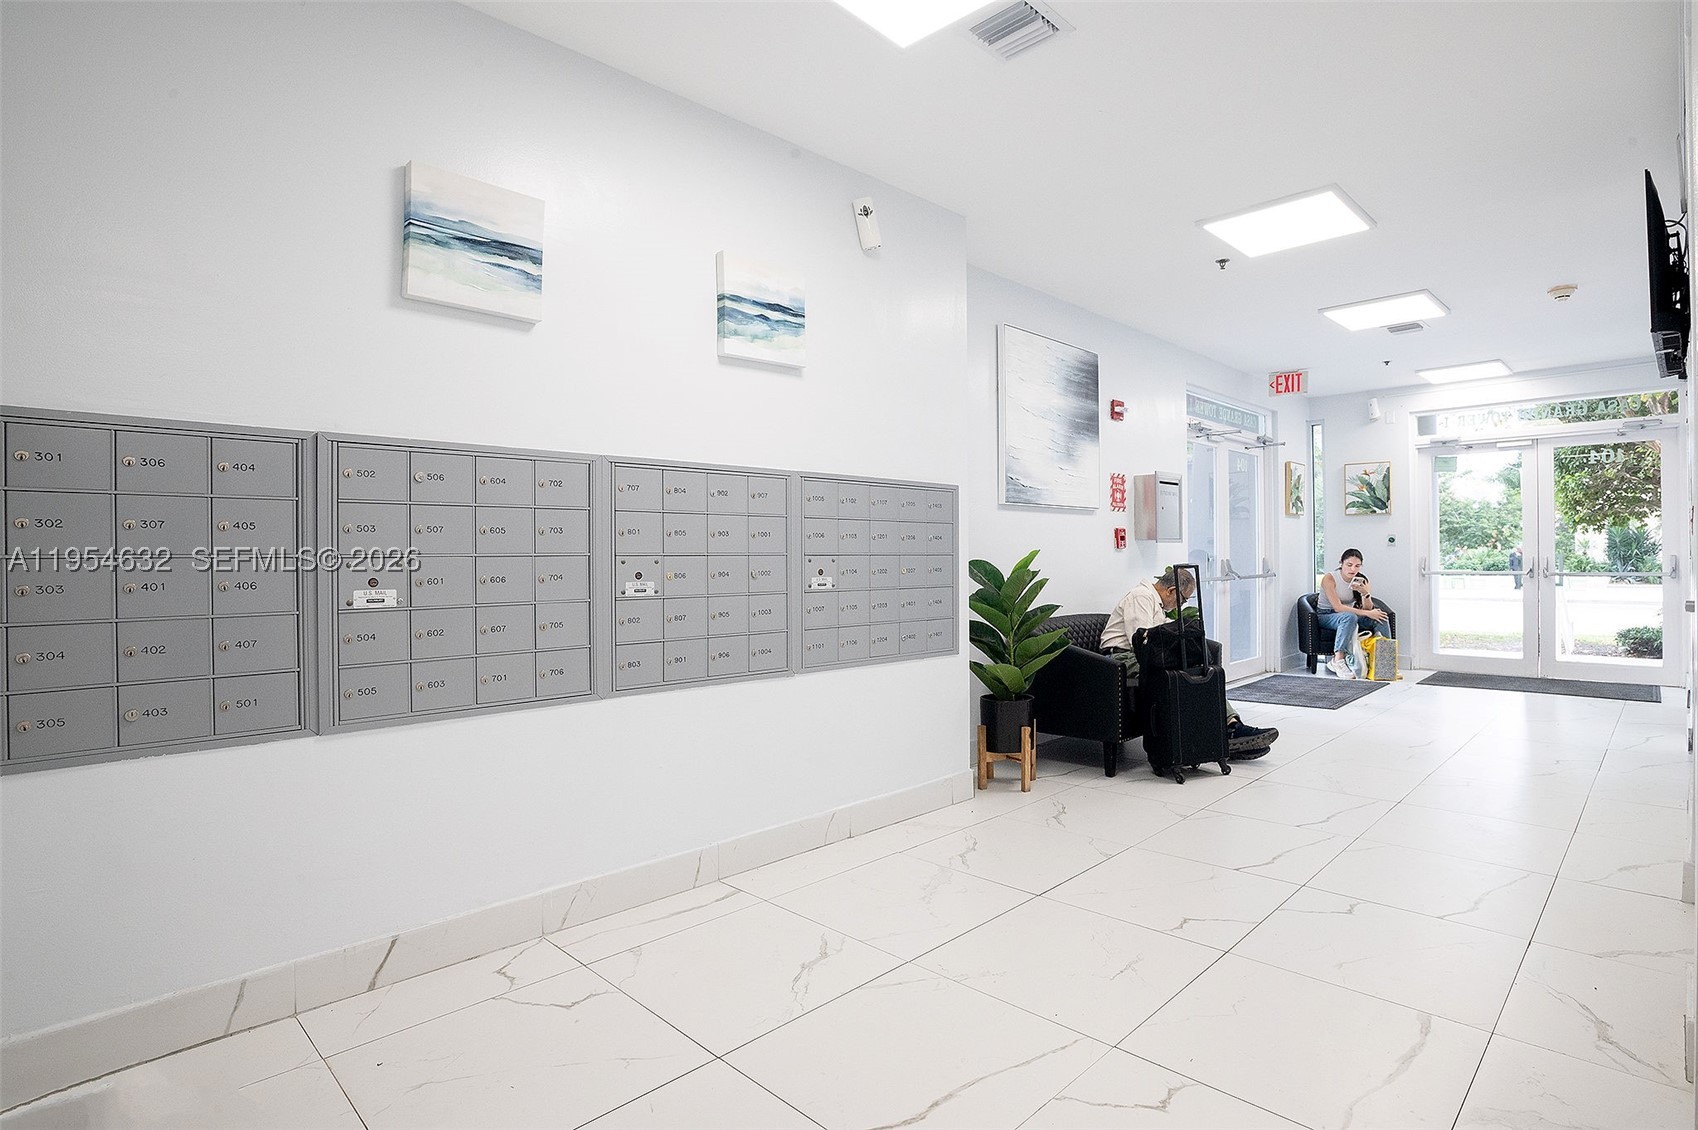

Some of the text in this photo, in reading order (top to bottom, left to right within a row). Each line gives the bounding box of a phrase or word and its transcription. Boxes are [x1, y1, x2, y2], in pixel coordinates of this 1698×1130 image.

[1276, 373, 1302, 394] EXIT
[34, 451, 62, 462] 301
[140, 457, 166, 468] 306
[232, 462, 256, 472] 404
[356, 469, 376, 478] 502
[426, 473, 445, 482] 506
[490, 477, 506, 485] 604
[548, 479, 563, 488] 702
[34, 518, 63, 529] 302
[140, 519, 165, 529] 307
[233, 521, 256, 531] 405
[356, 524, 376, 533] 503
[426, 525, 444, 534] 507
[489, 526, 506, 535] 605
[548, 526, 563, 535] 703
[427, 577, 444, 586] 601
[490, 576, 506, 584] 606
[548, 574, 563, 582] 704
[35, 584, 64, 595] 303
[140, 581, 166, 592] 401
[234, 581, 258, 591] 406
[490, 625, 506, 633] 607
[549, 621, 564, 629] 705
[356, 633, 376, 642] 504
[427, 629, 444, 637] 602
[234, 639, 258, 650] 407
[140, 645, 166, 656] 402
[35, 650, 65, 662] 304
[549, 668, 564, 676] 706
[492, 674, 507, 683] 701
[427, 680, 445, 689] 603
[357, 687, 377, 696] 505
[236, 698, 258, 709] 501
[142, 707, 168, 718] 403
[36, 717, 65, 728] 305
